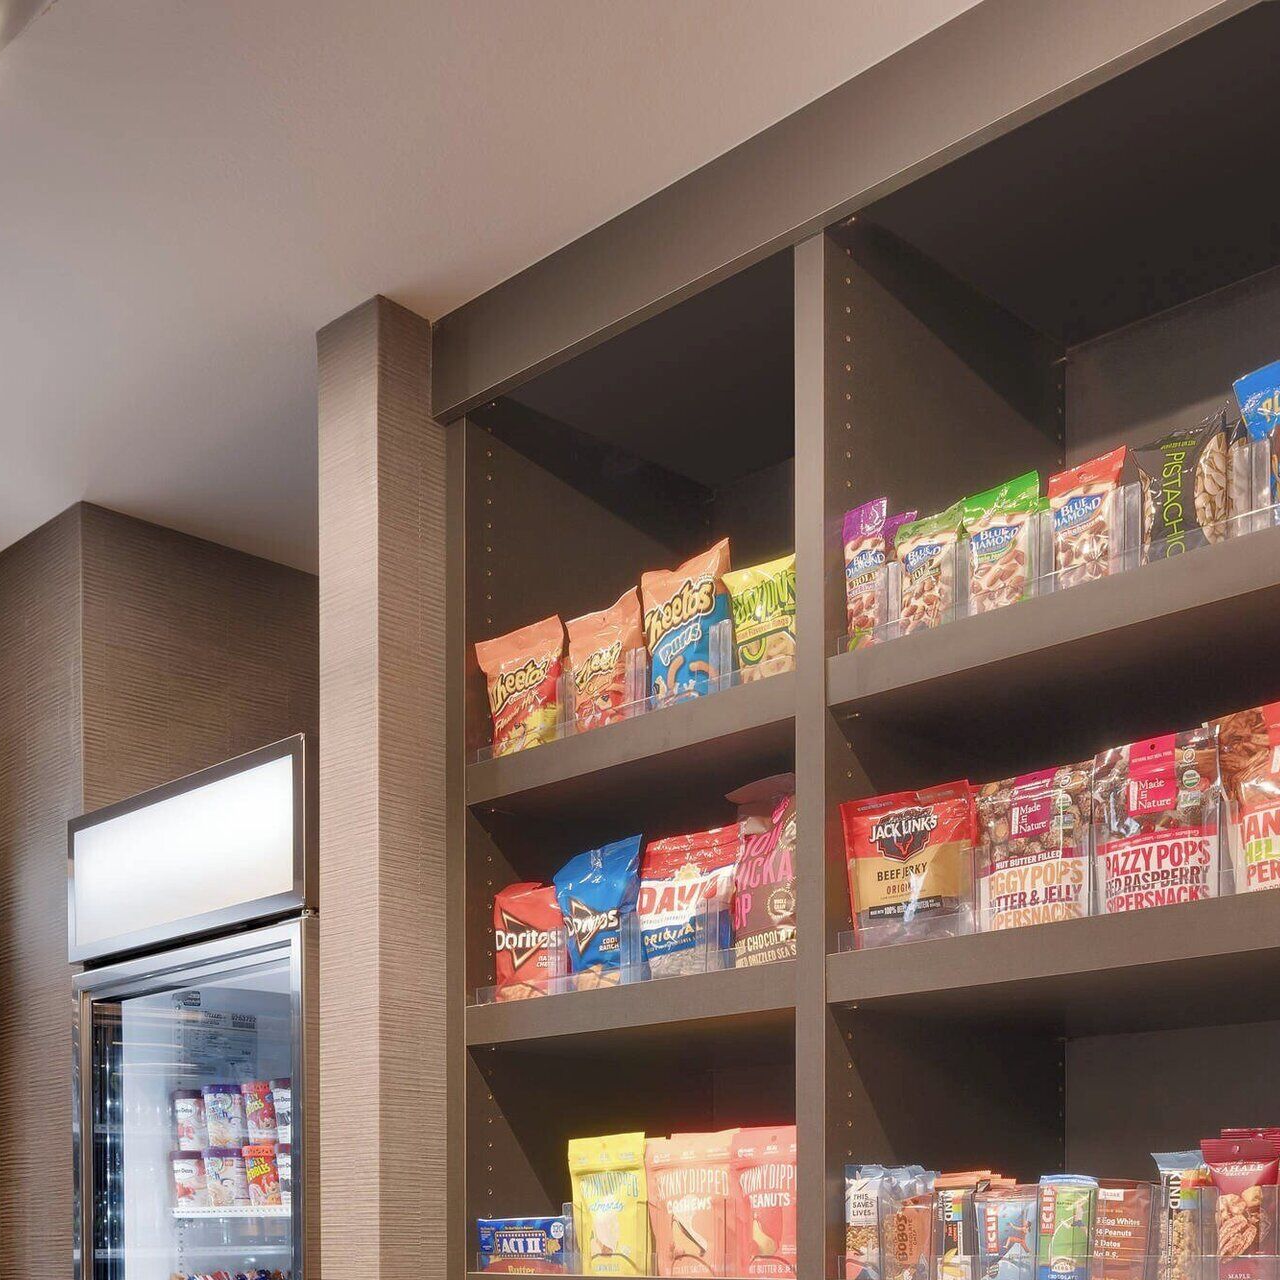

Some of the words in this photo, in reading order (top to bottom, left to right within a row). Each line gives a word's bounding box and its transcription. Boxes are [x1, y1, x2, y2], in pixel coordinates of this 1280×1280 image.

[1138, 777, 1165, 791] Made
[1019, 803, 1042, 815] Made
[1137, 797, 1171, 811] Nature
[869, 821, 904, 843] JACK
[1019, 818, 1048, 834] Nature
[1010, 855, 1037, 869] BUTTER
[1036, 849, 1062, 864] FILLED
[1155, 839, 1211, 870] POPS
[877, 868, 902, 882] BEEF
[1030, 859, 1083, 891] POPS
[1123, 865, 1209, 892] RASPBERRY
[1042, 884, 1083, 906] JELLY
[496, 930, 563, 950] Doritos
[1215, 1164, 1264, 1175] SAHALE
[853, 1193, 869, 1201] THIS
[1170, 1170, 1181, 1209] KIND
[852, 1201, 874, 1209] SAVES
[1104, 1228, 1132, 1237] Peanuts
[502, 1238, 525, 1254] ACT
